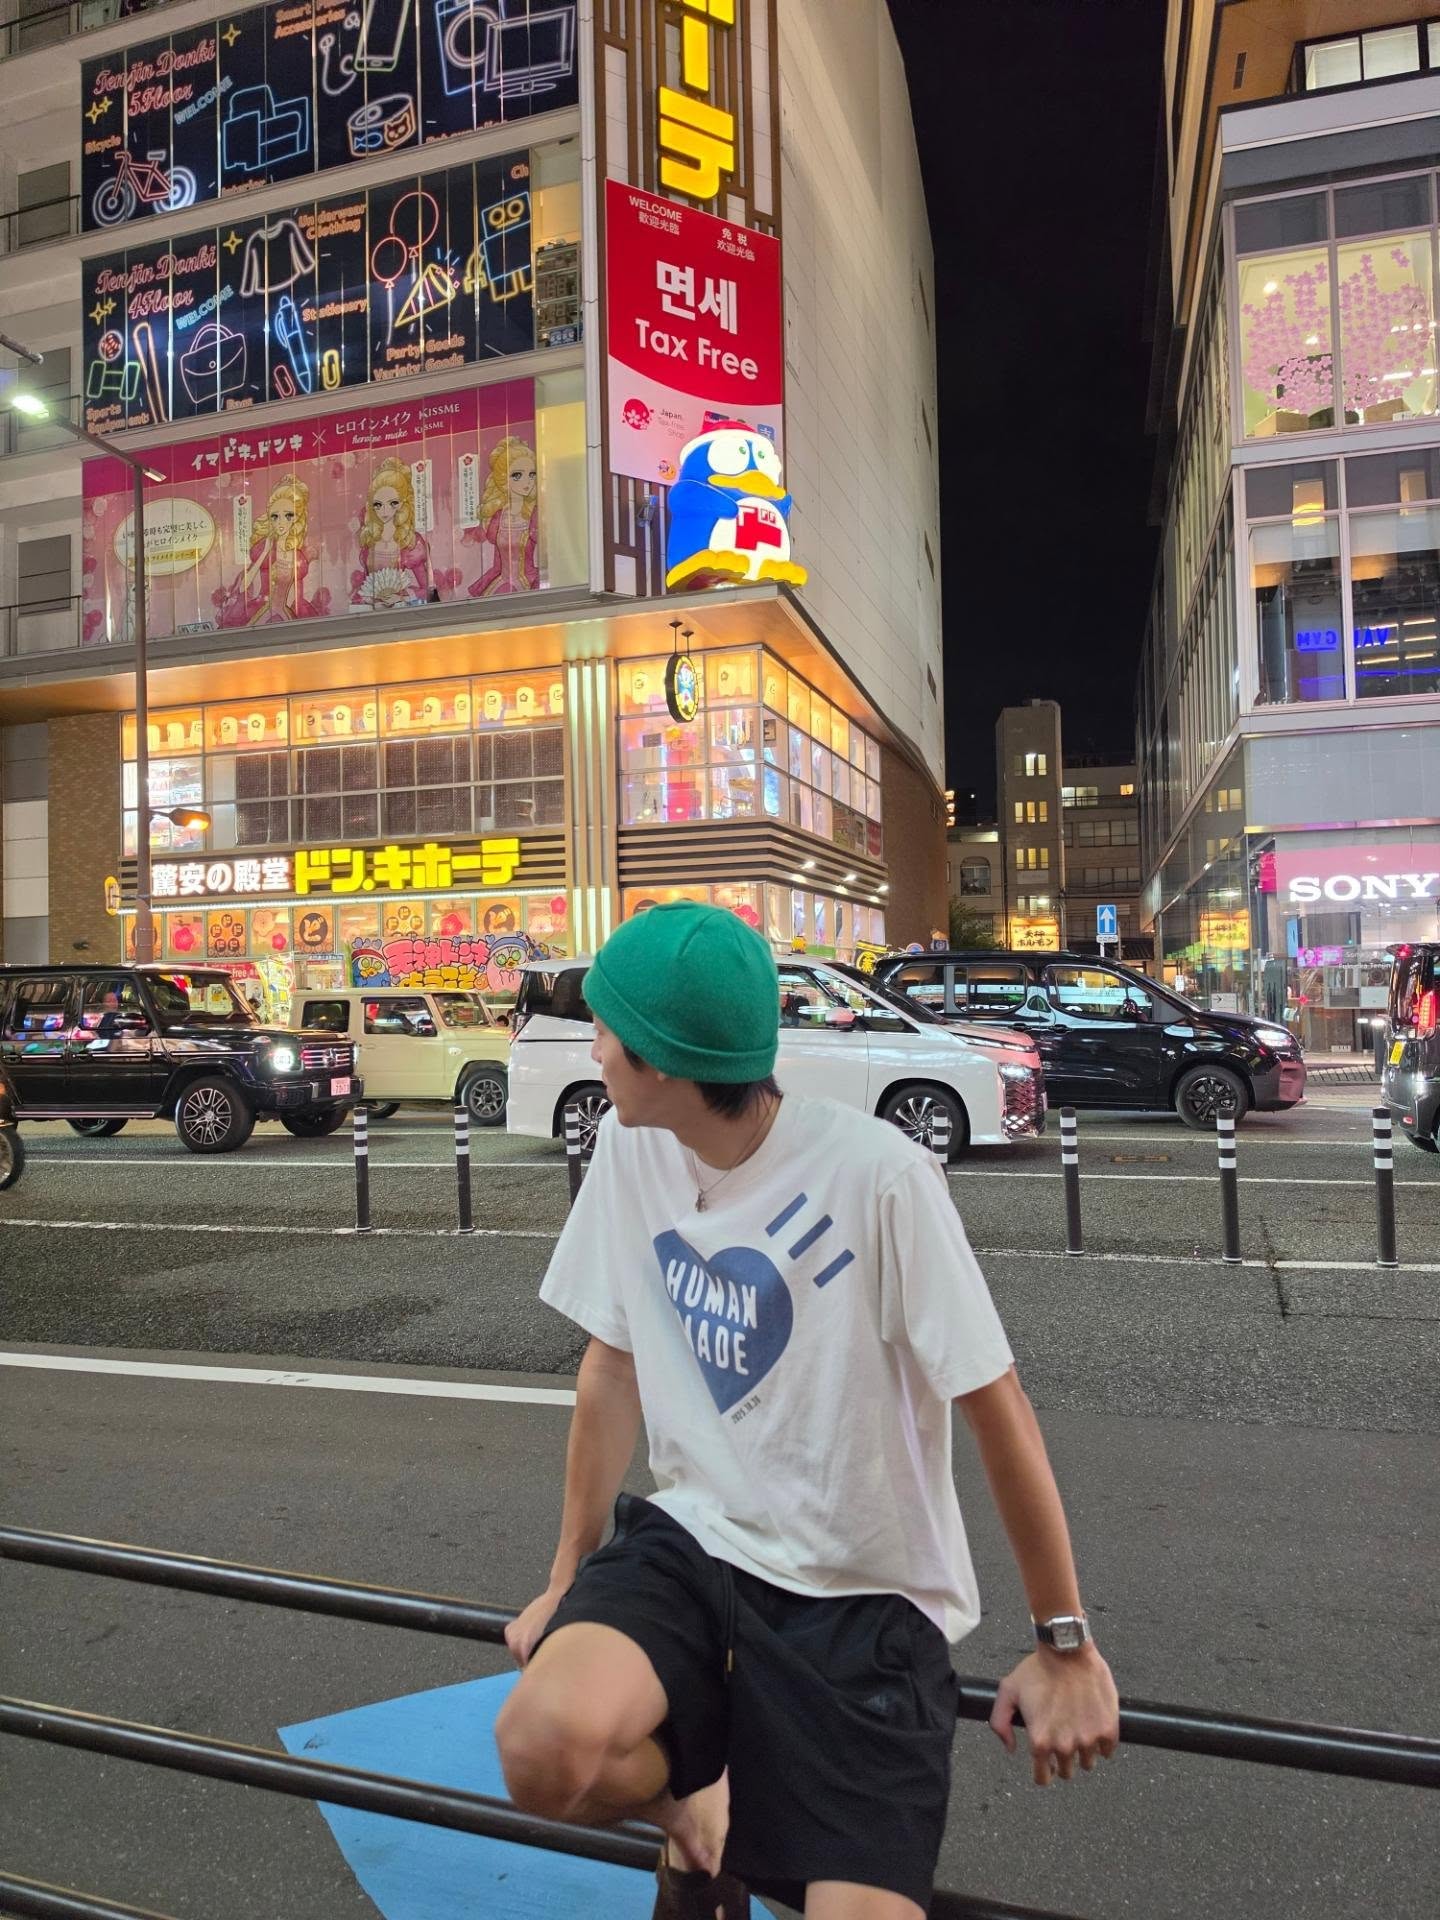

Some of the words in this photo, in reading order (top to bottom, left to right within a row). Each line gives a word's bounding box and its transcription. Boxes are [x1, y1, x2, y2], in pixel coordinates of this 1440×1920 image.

[93, 61, 154, 95] Tenjin
[156, 39, 216, 77] Donki
[174, 75, 233, 125] WELCOME
[85, 135, 121, 154] Bicycle
[298, 203, 367, 228] Underwear
[629, 195, 683, 222] WELCOME
[306, 219, 361, 240] Clothing
[95, 263, 155, 295] Tenjin
[155, 245, 217, 280] Donki
[175, 284, 234, 330] WELCOME
[302, 299, 368, 322] Stationery
[656, 260, 738, 335] 면세
[386, 344, 421, 361] Party
[426, 334, 465, 353] Goods
[635, 318, 689, 361] Tax
[698, 336, 759, 380] Free
[86, 404, 122, 422] Sports
[335, 411, 411, 435] ヒロインメイク
[419, 403, 461, 421] KISSME
[385, 427, 408, 441] make
[152, 857, 291, 897] 驚安の殿堂
[1289, 873, 1440, 902] SONY
[666, 1258, 758, 1330] HUMAN
